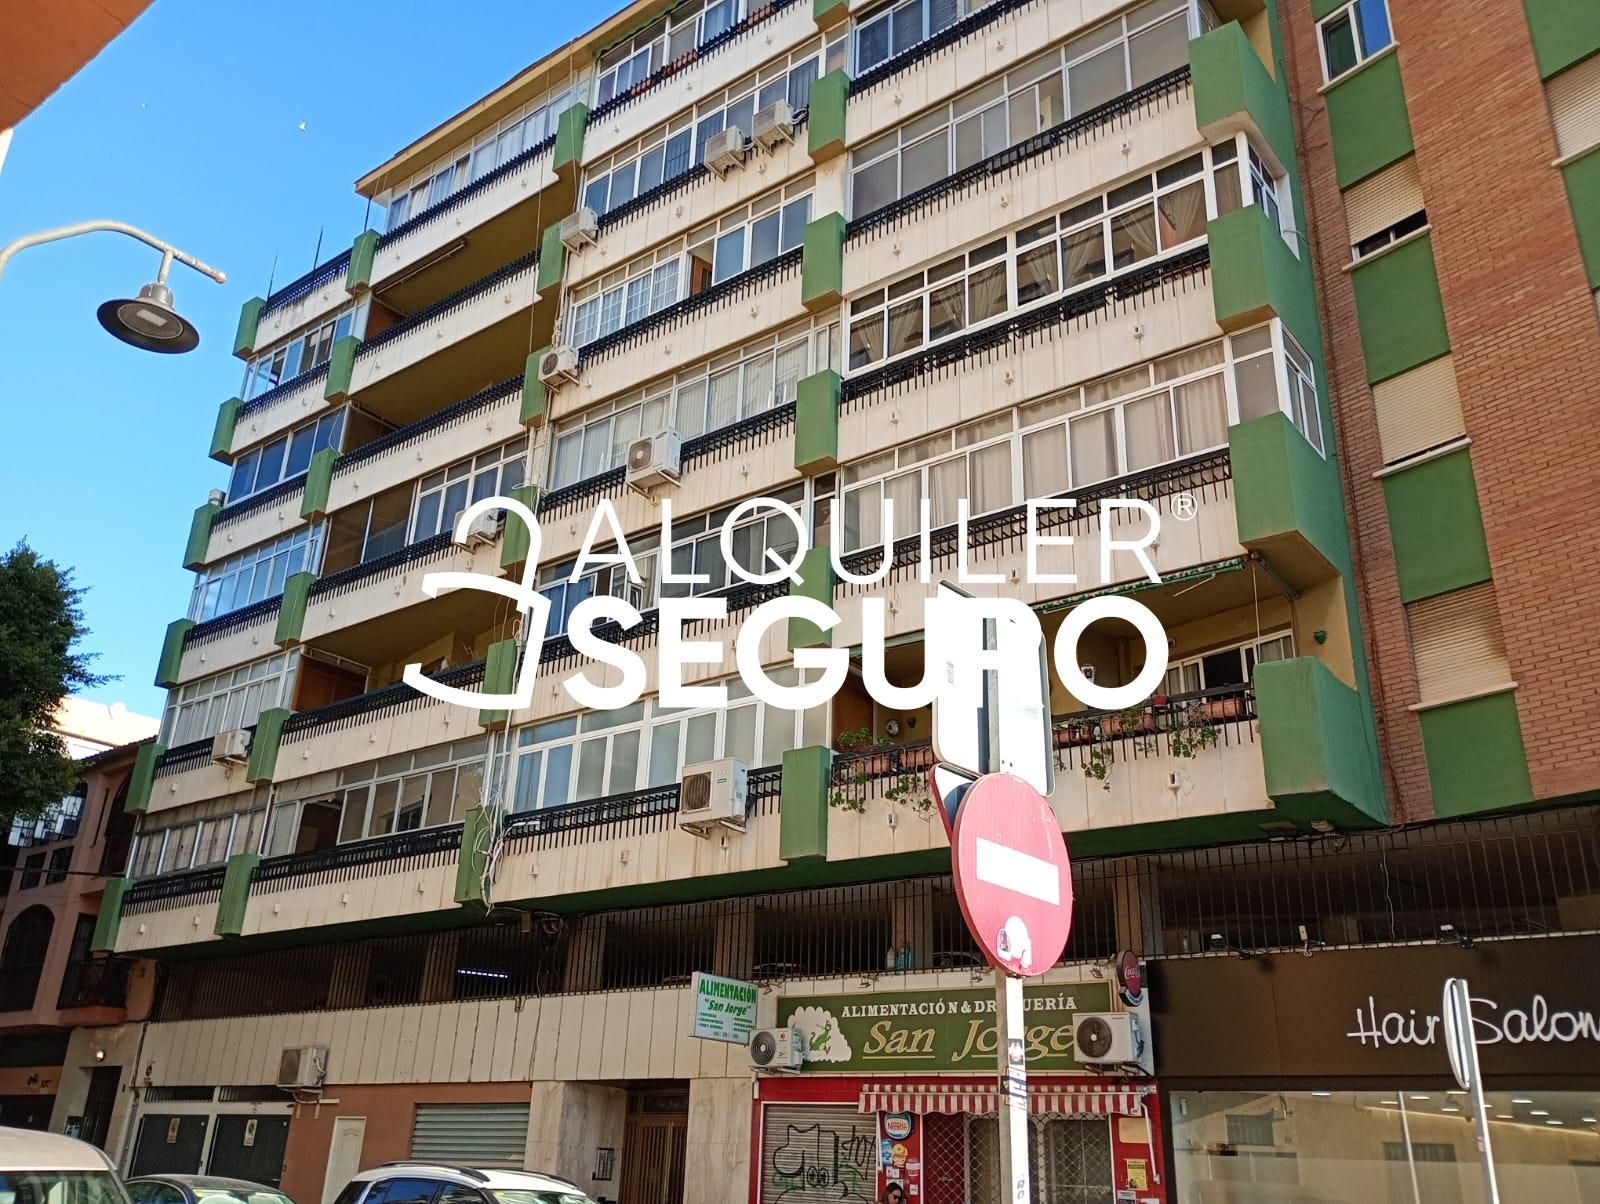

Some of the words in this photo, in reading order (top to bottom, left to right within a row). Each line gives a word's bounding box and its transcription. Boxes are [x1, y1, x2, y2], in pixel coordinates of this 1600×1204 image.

[699, 979, 757, 1004] ALIMENTACIÓN
[841, 998, 959, 1018] ALIMENTACIÓN
[974, 992, 1078, 1013] DRUERÍA
[863, 1020, 936, 1055] San
[951, 1018, 1077, 1062] Joge
[1346, 996, 1441, 1049] Hair
